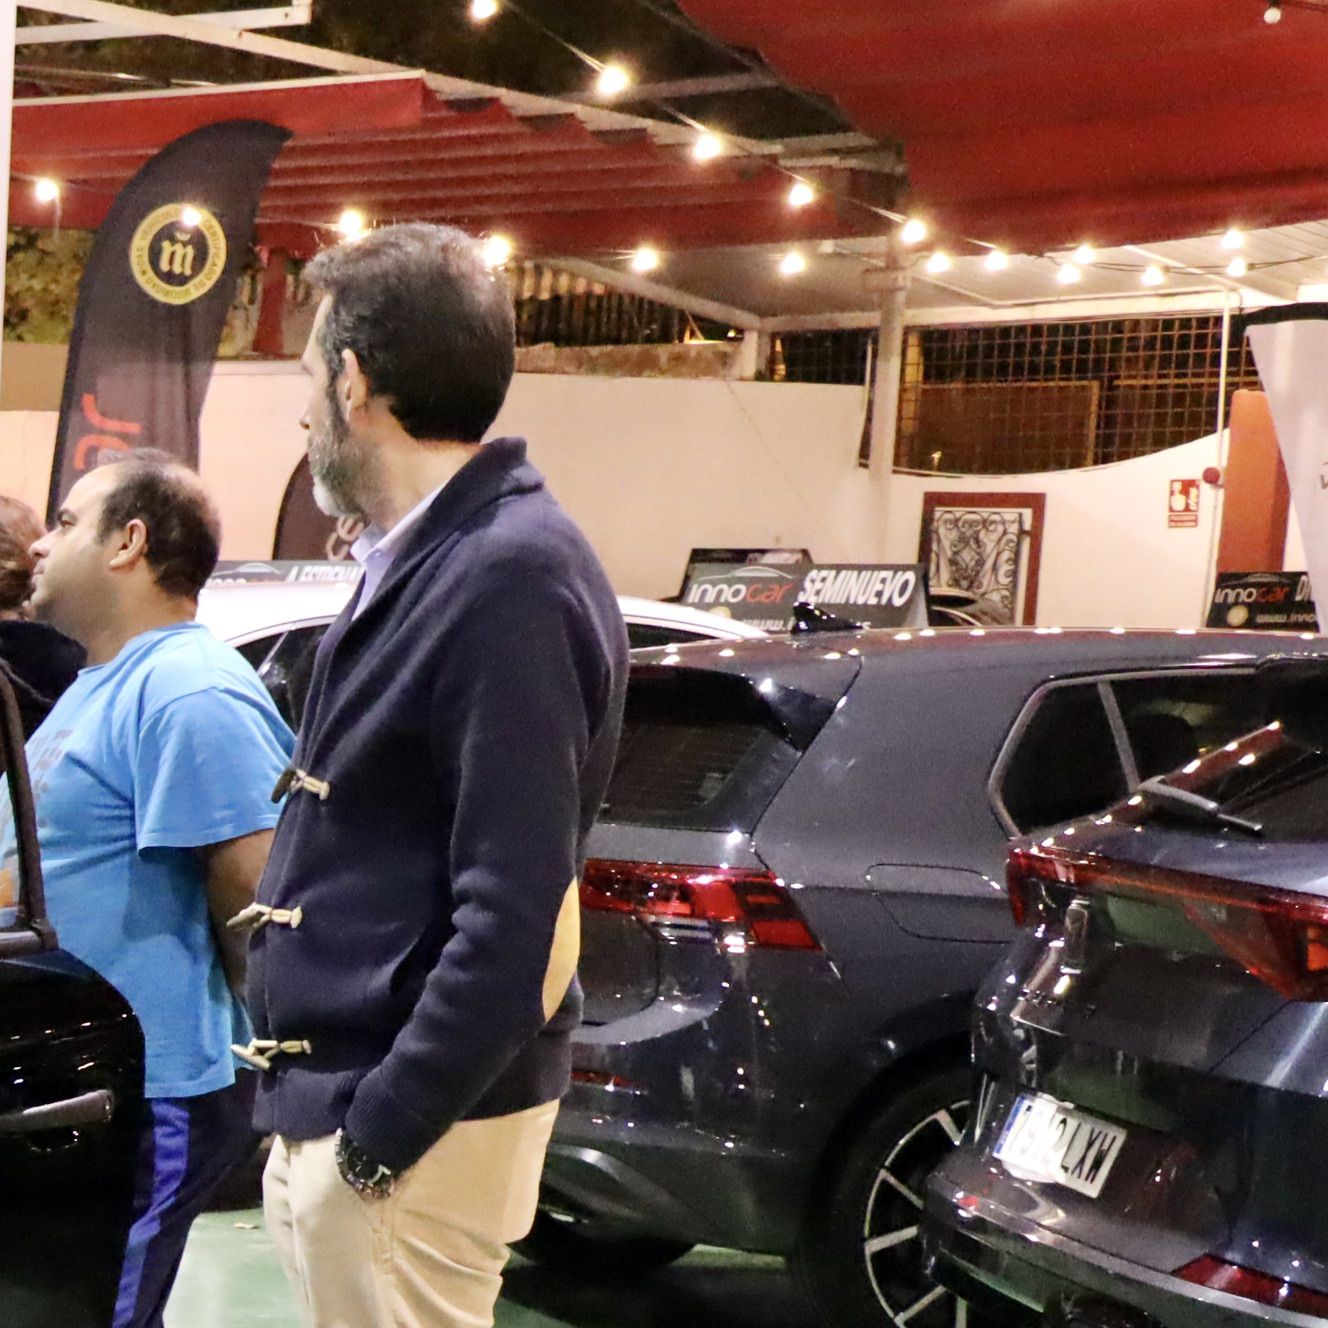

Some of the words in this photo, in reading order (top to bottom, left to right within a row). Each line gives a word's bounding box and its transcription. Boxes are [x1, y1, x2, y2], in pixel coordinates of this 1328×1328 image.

[300, 565, 366, 583] ESTRENA
[687, 582, 793, 604] innocar
[797, 569, 916, 607] SEMINUEVO
[1214, 586, 1291, 604] innocar
[1256, 611, 1316, 623] www.inno
